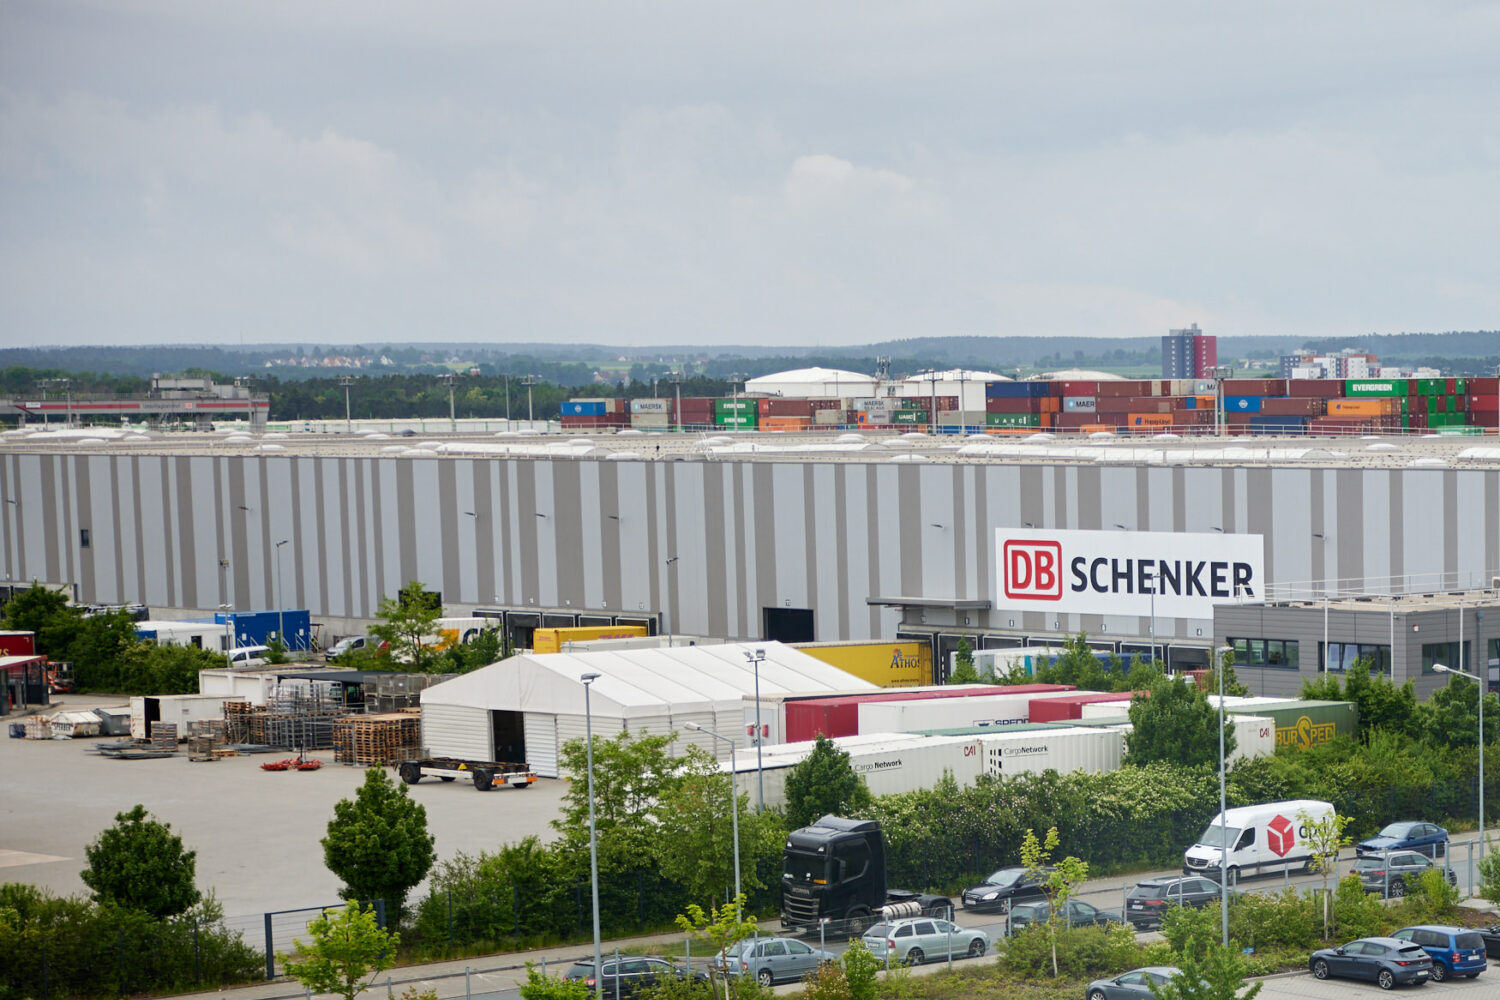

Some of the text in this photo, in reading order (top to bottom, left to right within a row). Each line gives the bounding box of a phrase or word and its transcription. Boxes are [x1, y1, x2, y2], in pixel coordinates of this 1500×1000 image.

[1352, 383, 1393, 391] EVERGREEN
[1010, 549, 1256, 598] DB SCHENKER
[963, 744, 976, 757] CAI
